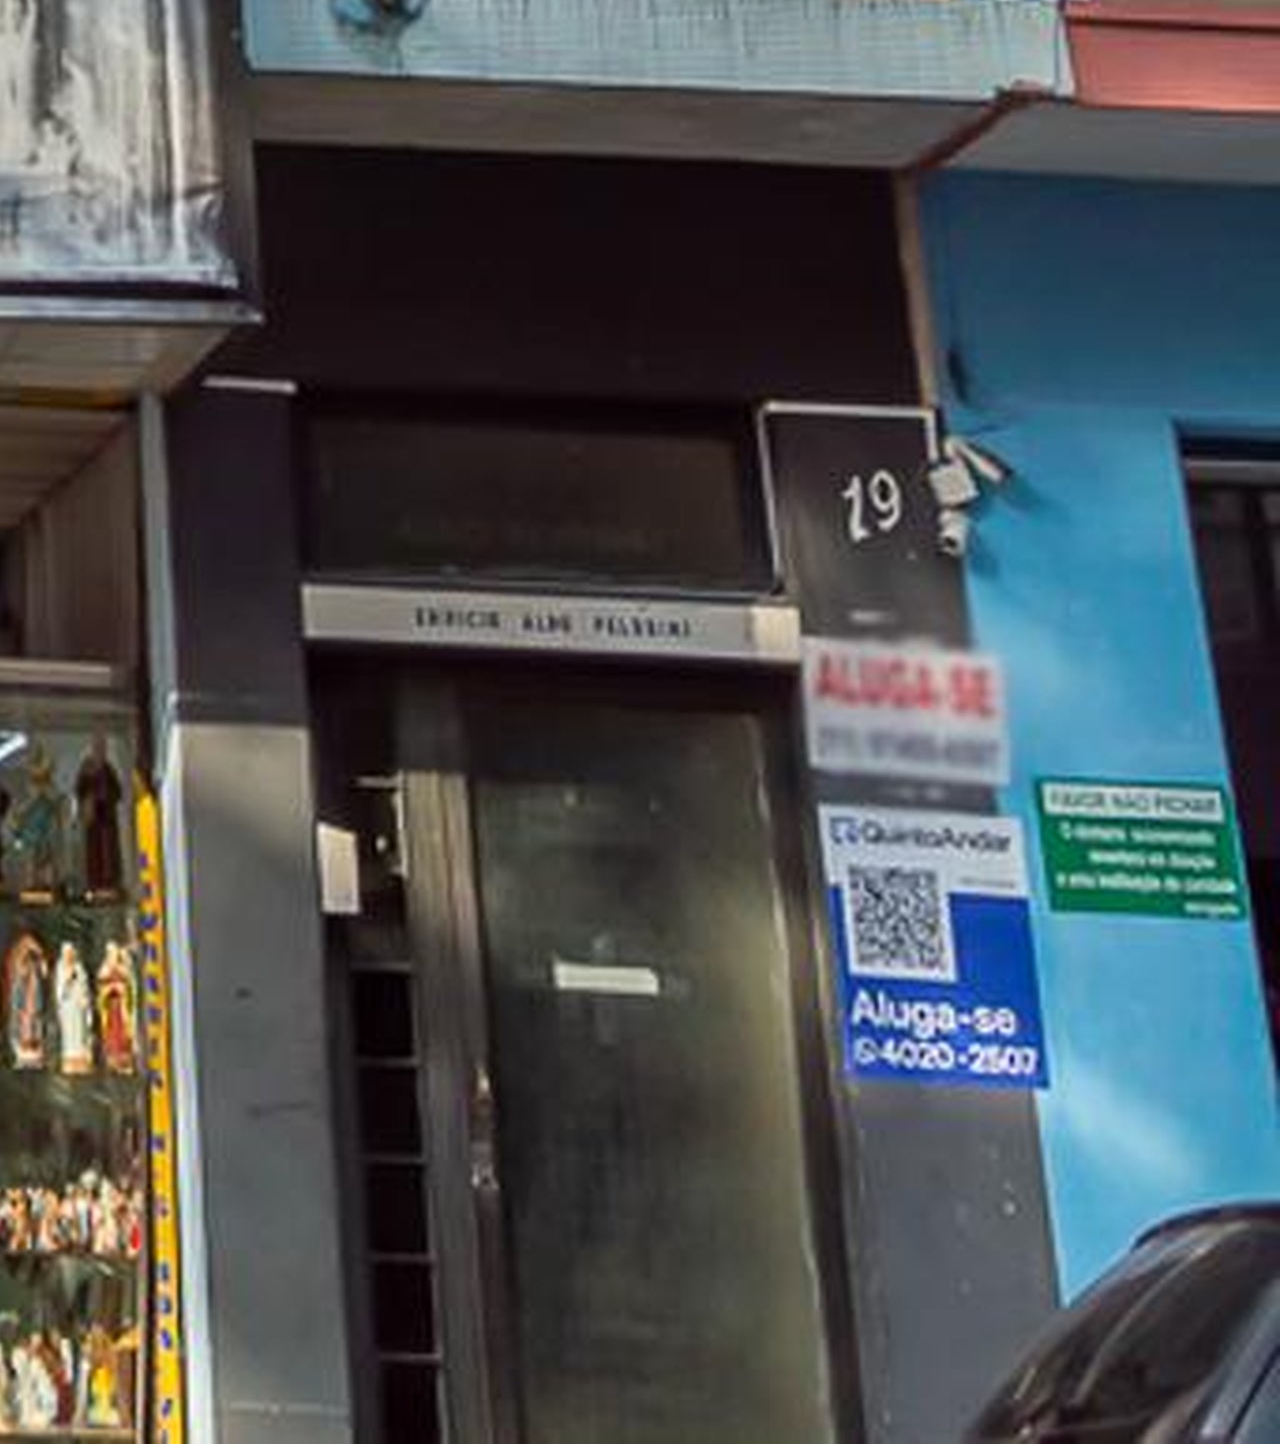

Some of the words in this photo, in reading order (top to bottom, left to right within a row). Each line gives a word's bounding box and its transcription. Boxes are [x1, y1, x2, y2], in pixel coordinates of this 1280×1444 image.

[841, 469, 901, 542] 19
[815, 652, 996, 719] ALUGA-SE
[861, 821, 1011, 853] QuintoAndar
[852, 989, 1017, 1039] Aluga-se
